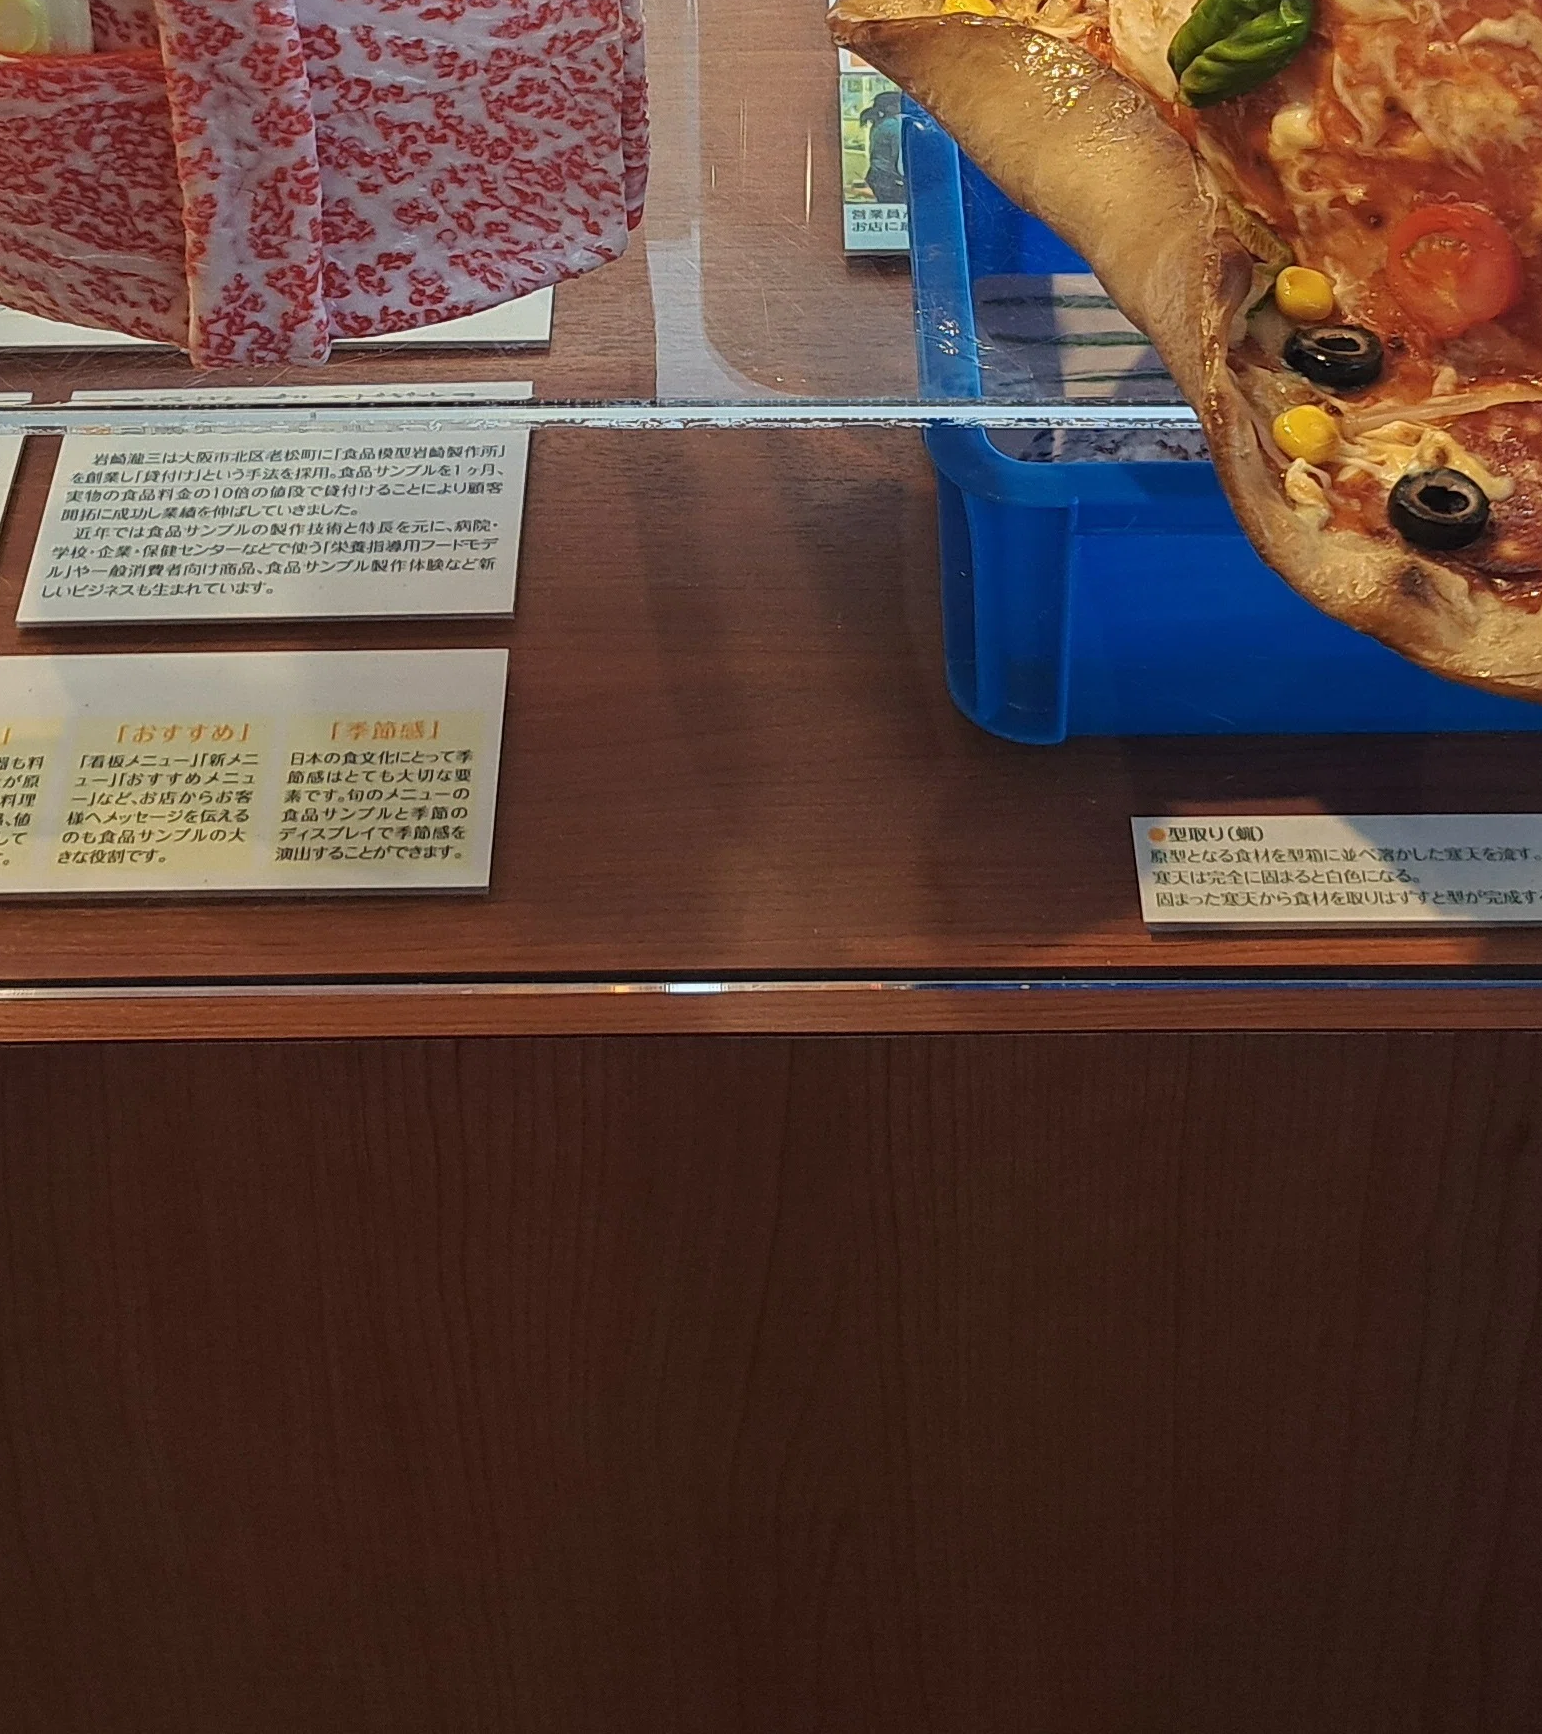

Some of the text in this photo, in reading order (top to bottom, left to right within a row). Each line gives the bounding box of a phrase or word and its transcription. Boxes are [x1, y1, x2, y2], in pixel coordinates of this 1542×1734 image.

[42, 582, 274, 599] しいビジネスも生まれています。
[117, 723, 251, 744] 「おすすめ」
[331, 720, 441, 741] 「季節感」
[79, 753, 258, 769] 「看板メニュー」「新メニ
[290, 749, 473, 765] 日本の食文化にとって季
[286, 768, 472, 784] 節感はとても大切な要
[72, 790, 254, 806] ー」など、お店からお客
[284, 787, 470, 803] 素です。旬のメニューの
[66, 809, 250, 826] 様へメッセージを伝える
[281, 806, 468, 822] 食品サンプルと季節の
[61, 827, 246, 844] のも食品サンプルの大
[279, 825, 466, 842] ディスプレイで季節感を
[57, 848, 167, 864] きな役割です。
[275, 845, 462, 861] 演出することができます。
